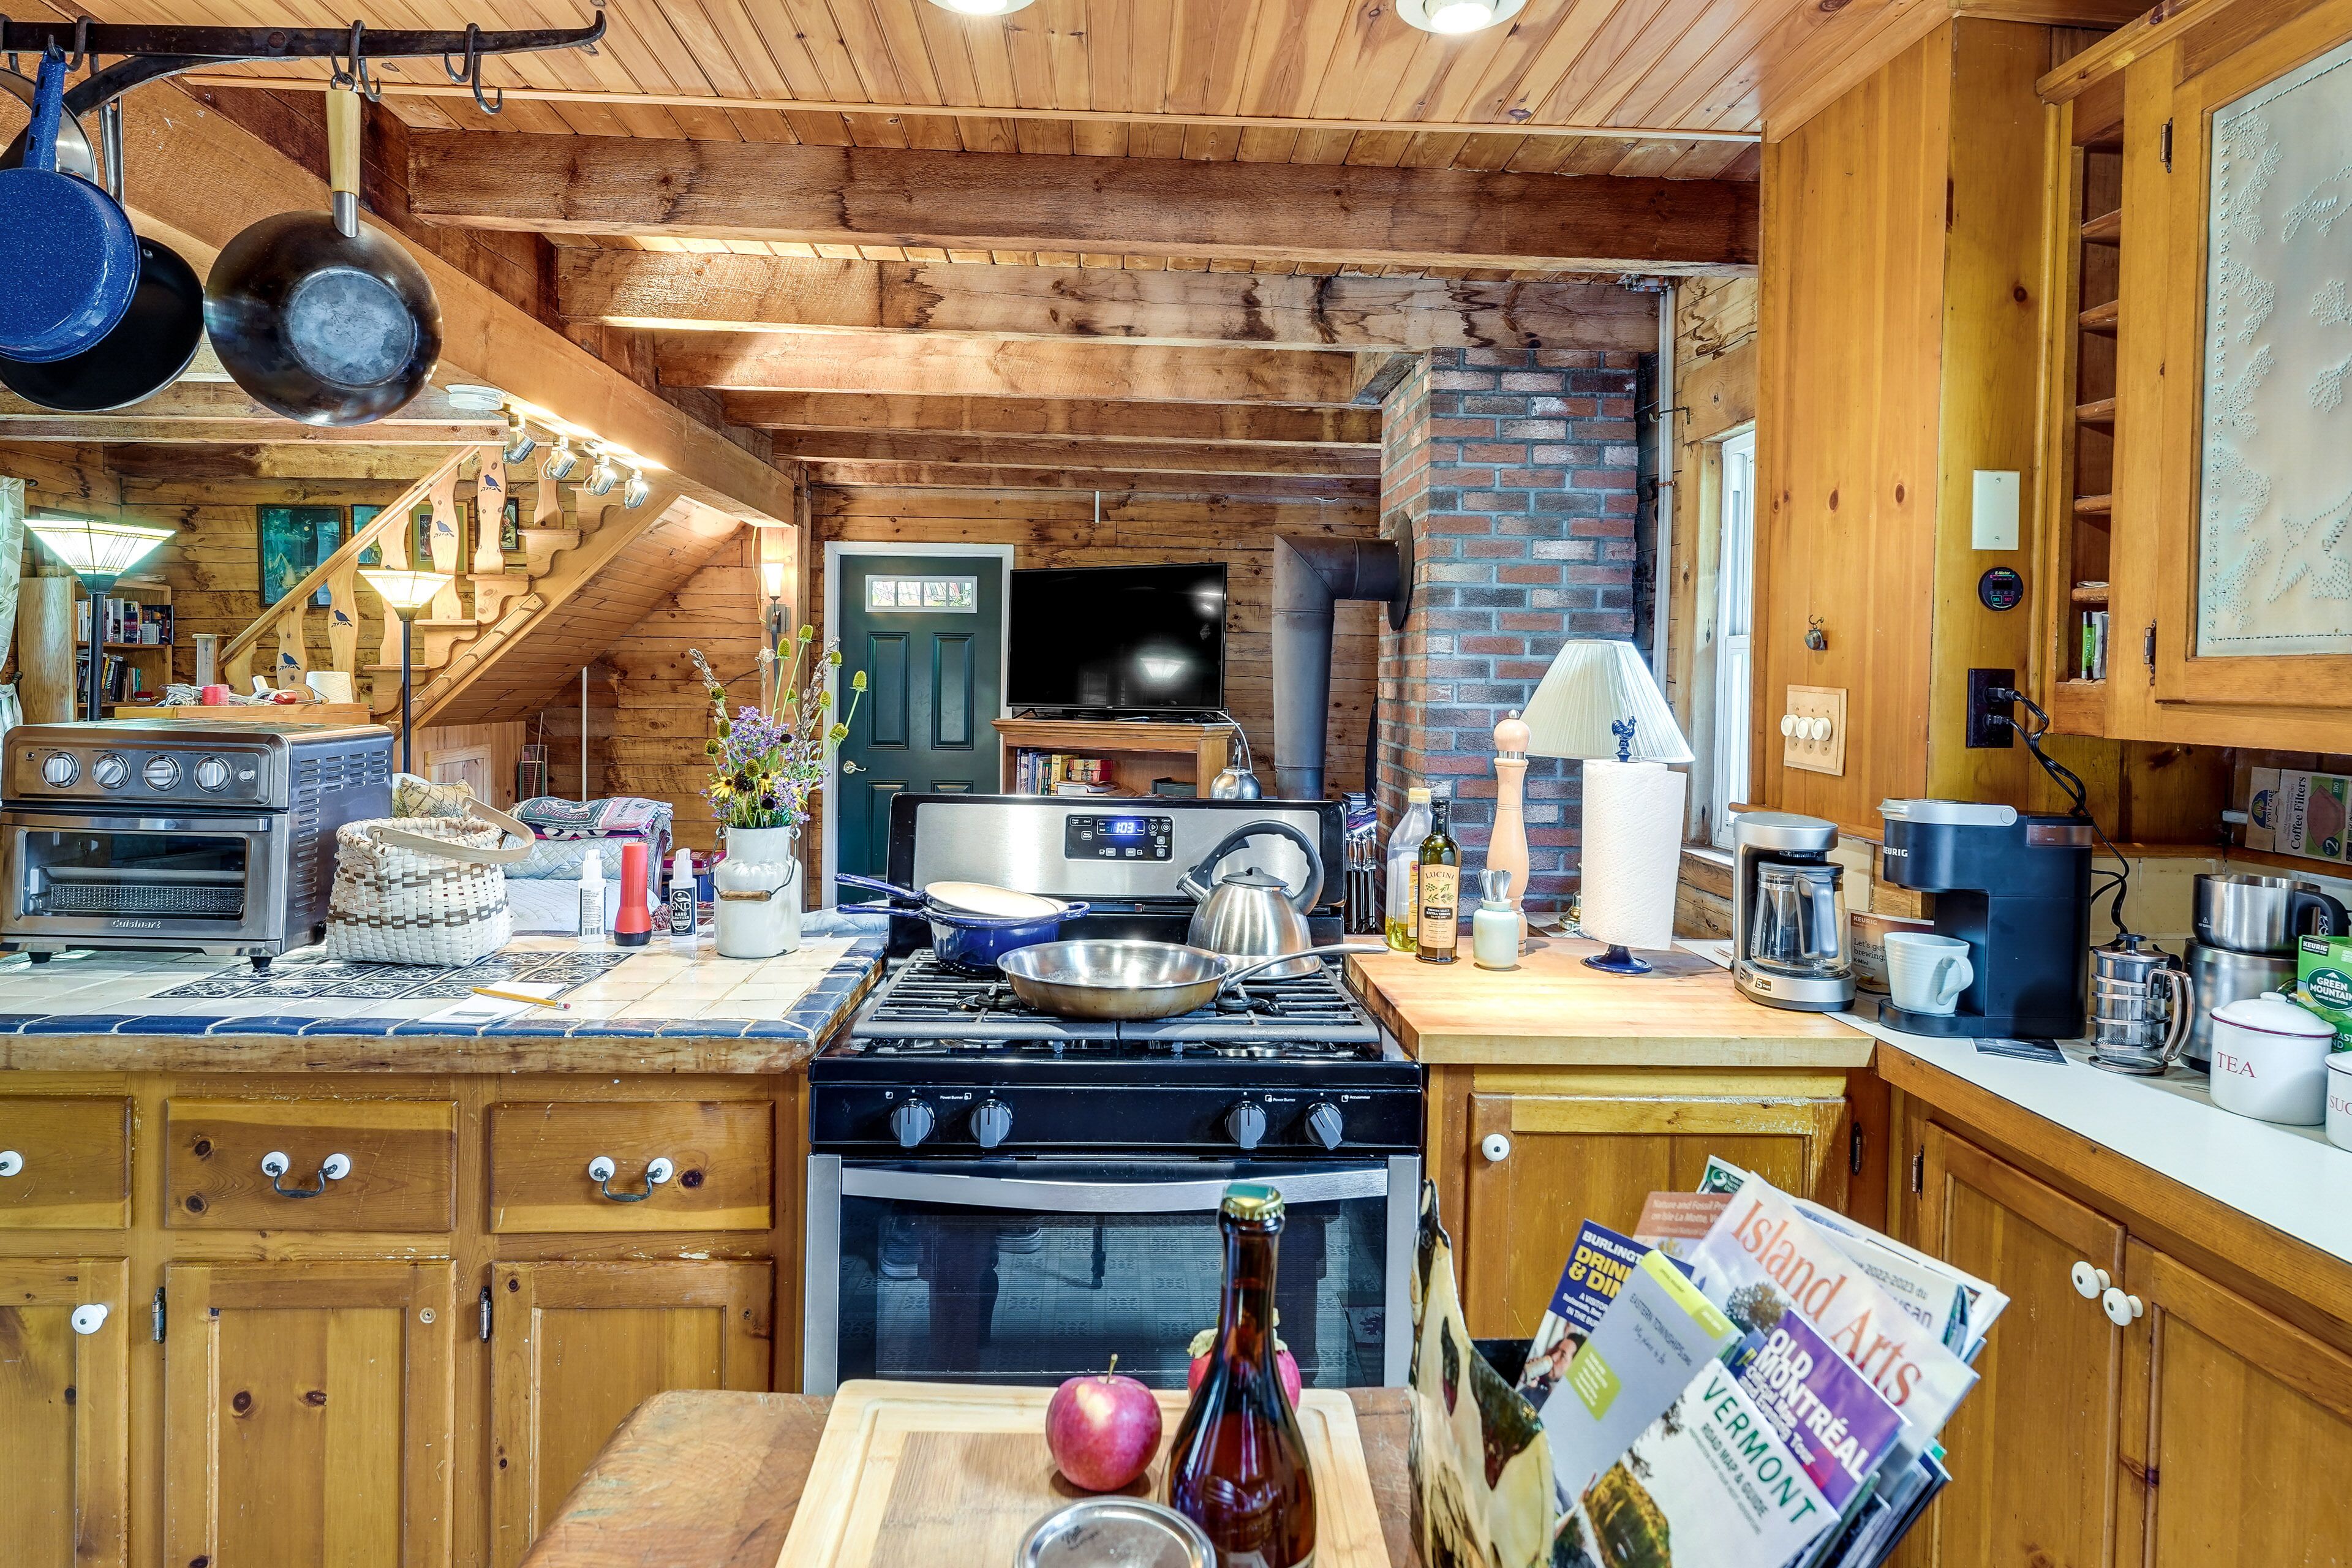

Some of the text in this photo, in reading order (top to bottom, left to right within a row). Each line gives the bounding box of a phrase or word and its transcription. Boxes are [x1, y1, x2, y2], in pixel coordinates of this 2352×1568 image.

[2291, 777, 2307, 850] Coffee Filters
[2326, 839, 2339, 851] 2
[1425, 871, 1455, 880] LUCINI
[671, 901, 692, 911] SND
[112, 919, 161, 929] Cuisinart
[1853, 916, 1877, 925] KEURIG
[1853, 937, 1871, 948] Let's
[2303, 941, 2329, 951] KEURIG
[1853, 946, 1886, 962] brewing.
[1853, 957, 1869, 965] K-Mini
[2310, 983, 2352, 1001] MOUNTAIN
[2316, 976, 2348, 991] GREEN
[2217, 1052, 2256, 1078] TEA
[2329, 1095, 2352, 1116] SU
[1582, 1230, 1644, 1265] BURLINGT
[1569, 1262, 1622, 1299] & DIN
[1865, 1263, 1915, 1294] 2022-2023
[1566, 1306, 1574, 1316] IN
[1732, 1199, 1848, 1323] Island
[1830, 1308, 1922, 1406] Arts
[1768, 1328, 1814, 1380] OLD
[1753, 1345, 1869, 1484] MONTRÉAL
[1701, 1422, 1722, 1452] ROAD
[1719, 1449, 1738, 1471] MAP
[1734, 1472, 1744, 1484] &
[1703, 1376, 1817, 1523] VERMONT
[1790, 1431, 1815, 1466] Tour
